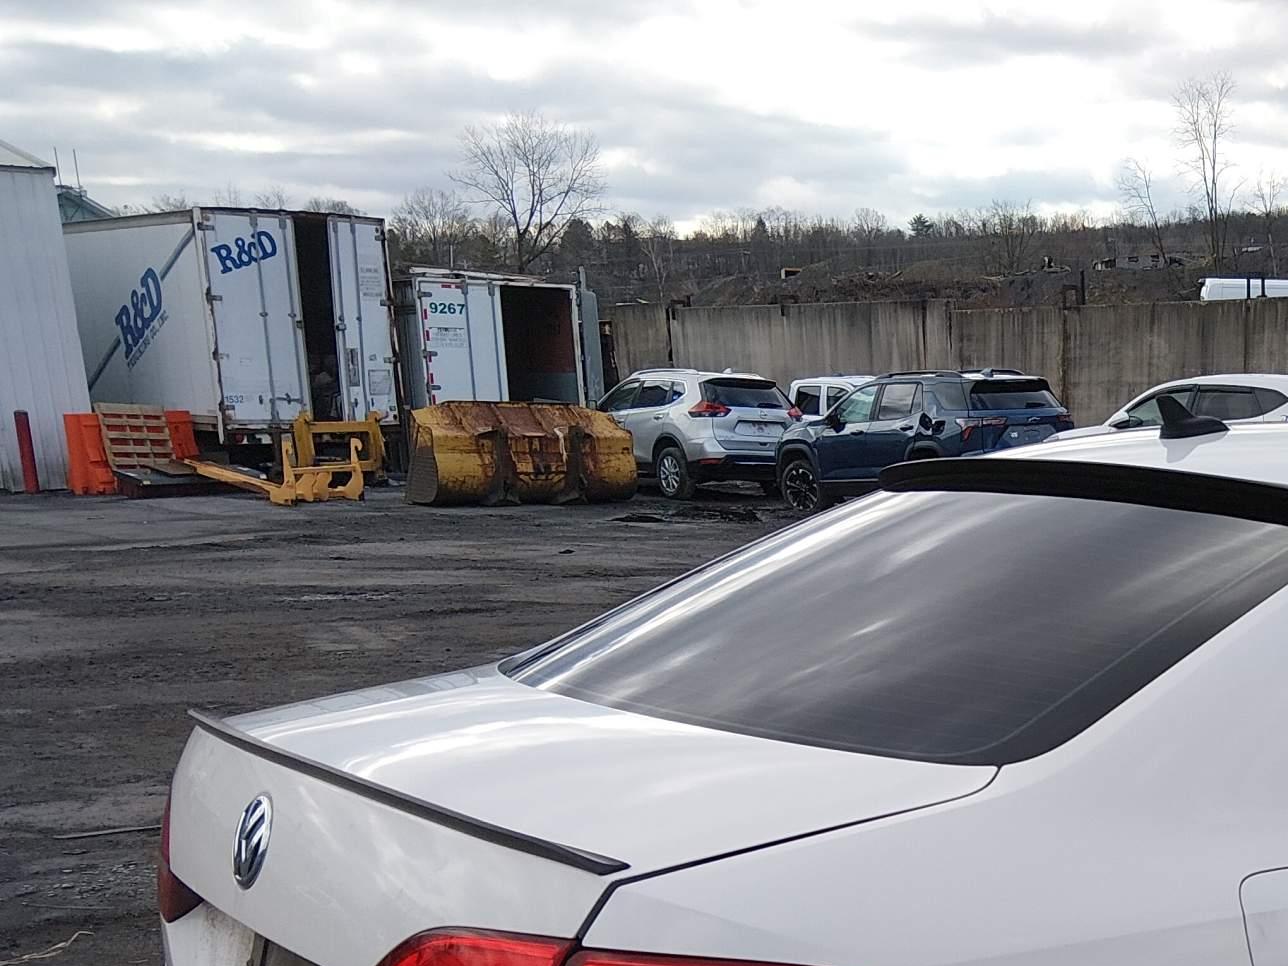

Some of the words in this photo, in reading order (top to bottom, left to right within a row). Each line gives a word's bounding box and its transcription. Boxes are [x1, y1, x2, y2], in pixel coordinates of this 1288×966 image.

[210, 230, 278, 274] R&D
[115, 267, 162, 360] R&D
[429, 302, 465, 315] 9267
